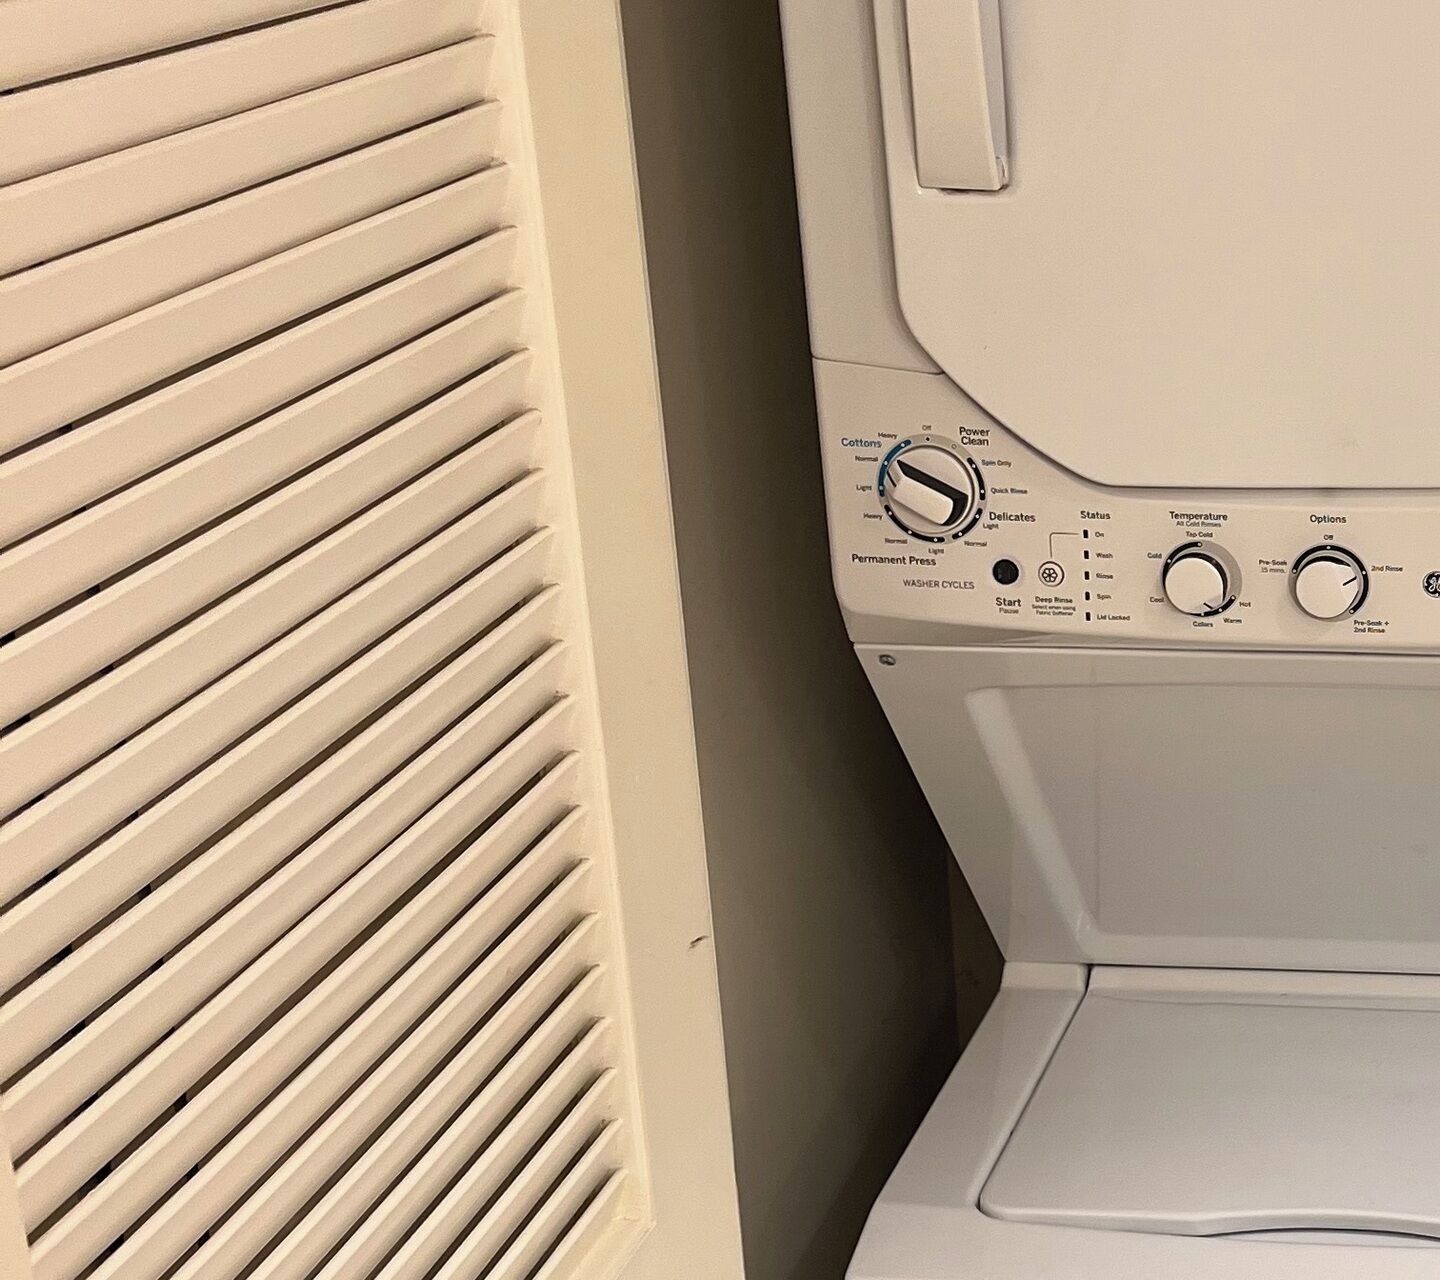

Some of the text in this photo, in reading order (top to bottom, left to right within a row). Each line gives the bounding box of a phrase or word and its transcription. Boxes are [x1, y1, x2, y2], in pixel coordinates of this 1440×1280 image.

[921, 424, 932, 432] Off
[959, 426, 990, 437] Power
[877, 432, 898, 440] Heavy
[841, 437, 882, 449] Cottons
[961, 436, 989, 447] Clean
[855, 455, 879, 463] Normal
[981, 459, 997, 467] Spin
[856, 484, 873, 493] Light
[991, 487, 1029, 496] Quick Rinse
[864, 512, 884, 521] Heavy
[989, 511, 1037, 523] Delicates
[1080, 510, 1112, 520] Status
[1169, 511, 1229, 522] Temperature
[1309, 514, 1348, 525] Options
[983, 523, 999, 531] Light
[1185, 531, 1198, 539] Tap
[1323, 533, 1335, 542] Off
[884, 537, 908, 545] Normal
[963, 540, 988, 548] Normal
[928, 547, 945, 556] Light
[851, 553, 937, 567] Permanent Press
[1146, 552, 1163, 560] Cold
[1258, 559, 1288, 567] Pre-Soak
[1370, 565, 1404, 573] 2nd Rinse
[1095, 572, 1114, 580] Rinse
[902, 579, 976, 590] WASHER CYCLES
[1034, 595, 1074, 604] Deep Rinse
[1096, 593, 1112, 601] Spin
[995, 596, 1022, 608] Start
[998, 607, 1020, 615] Pause
[1107, 613, 1131, 621] Locked
[1223, 617, 1243, 625] Warm
[1192, 621, 1214, 629] Colors
[1353, 619, 1383, 627] Pre-Soak
[1353, 626, 1386, 634] 2nd Rinse
